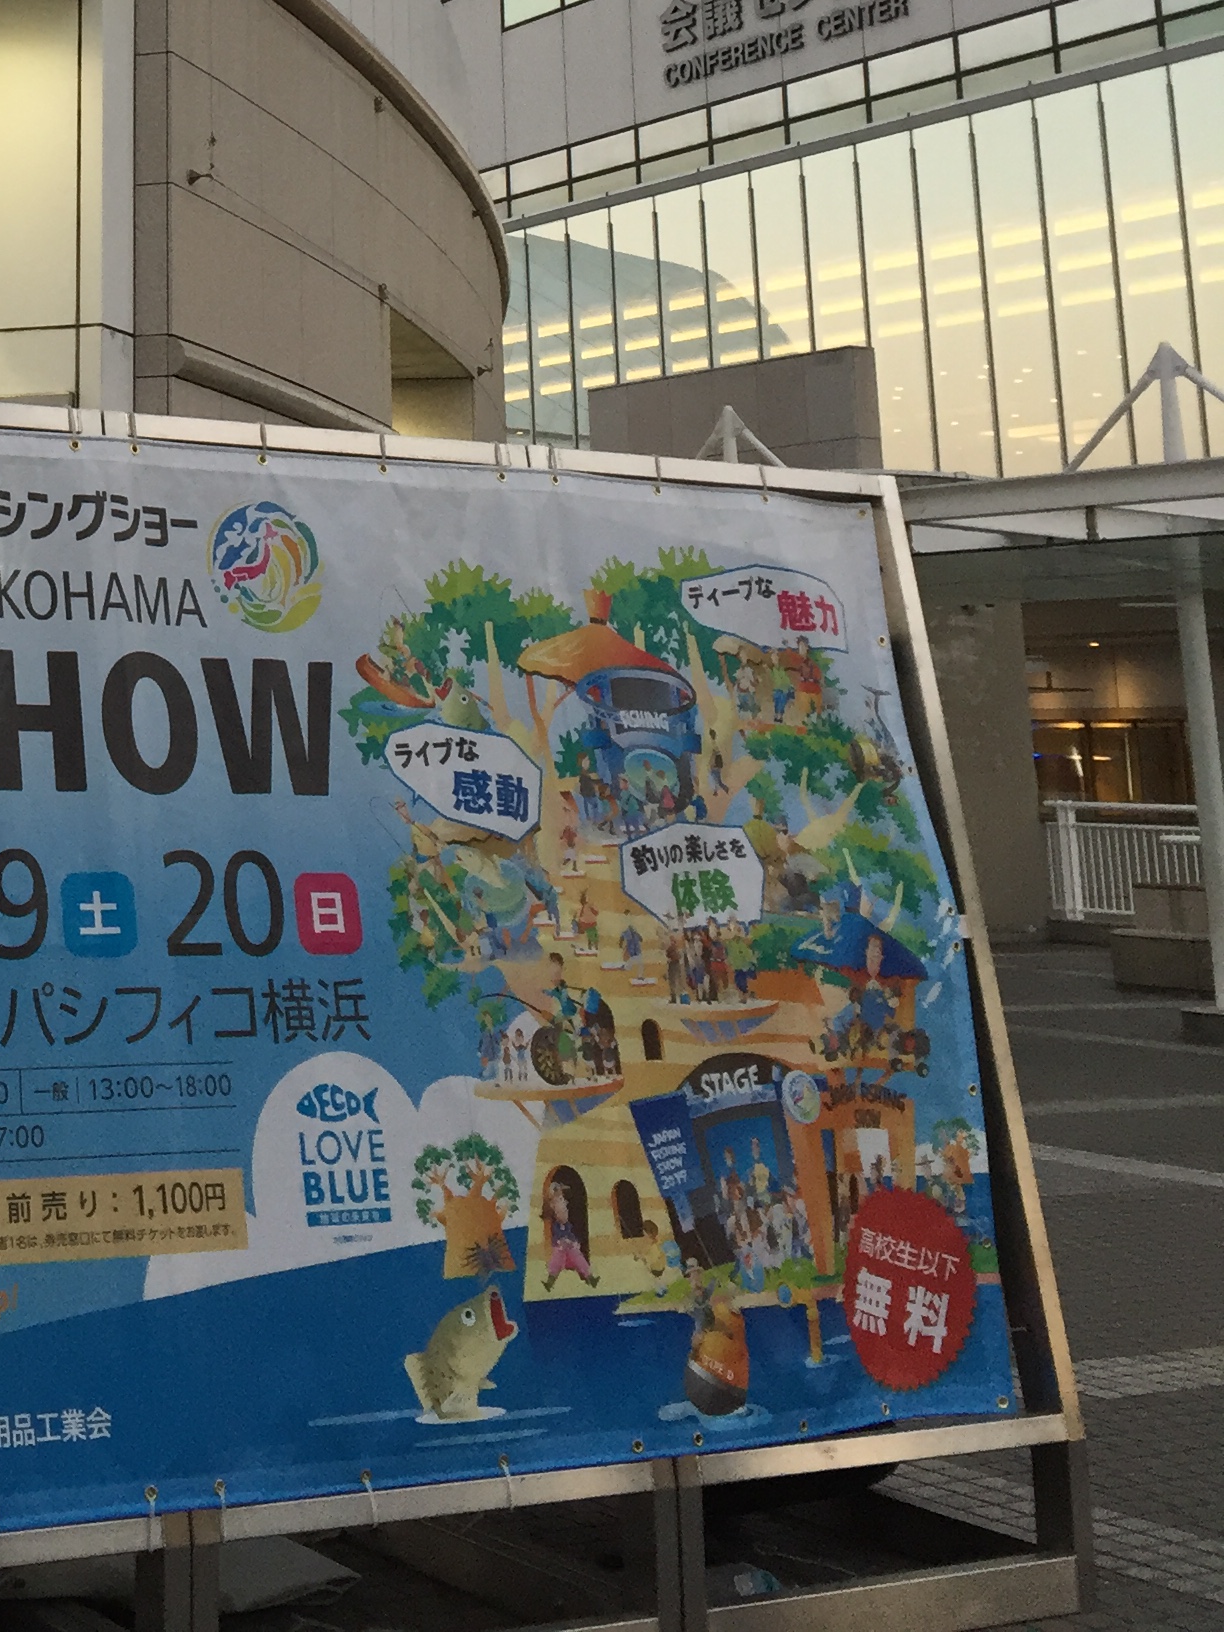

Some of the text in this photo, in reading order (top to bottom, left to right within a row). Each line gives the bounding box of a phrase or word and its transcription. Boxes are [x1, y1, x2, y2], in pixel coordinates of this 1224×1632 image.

[663, 23, 805, 88] CONFERENCE
[686, 574, 775, 608] ディープな
[776, 590, 839, 637] 魅力
[392, 737, 479, 769] ライブな
[451, 769, 529, 823] 感動
[630, 835, 746, 877] 釣りの楽しさを
[79, 890, 122, 936] 土
[162, 848, 285, 957] 20
[310, 893, 346, 936] 日
[670, 868, 739, 915] 体験
[33, 1081, 70, 1102] 一般
[700, 1064, 759, 1103] STAGE
[299, 1130, 385, 1166] LOVE
[302, 1168, 391, 1205] BLUE
[858, 1226, 961, 1281] 高校生以下
[852, 1266, 950, 1354] 無料
